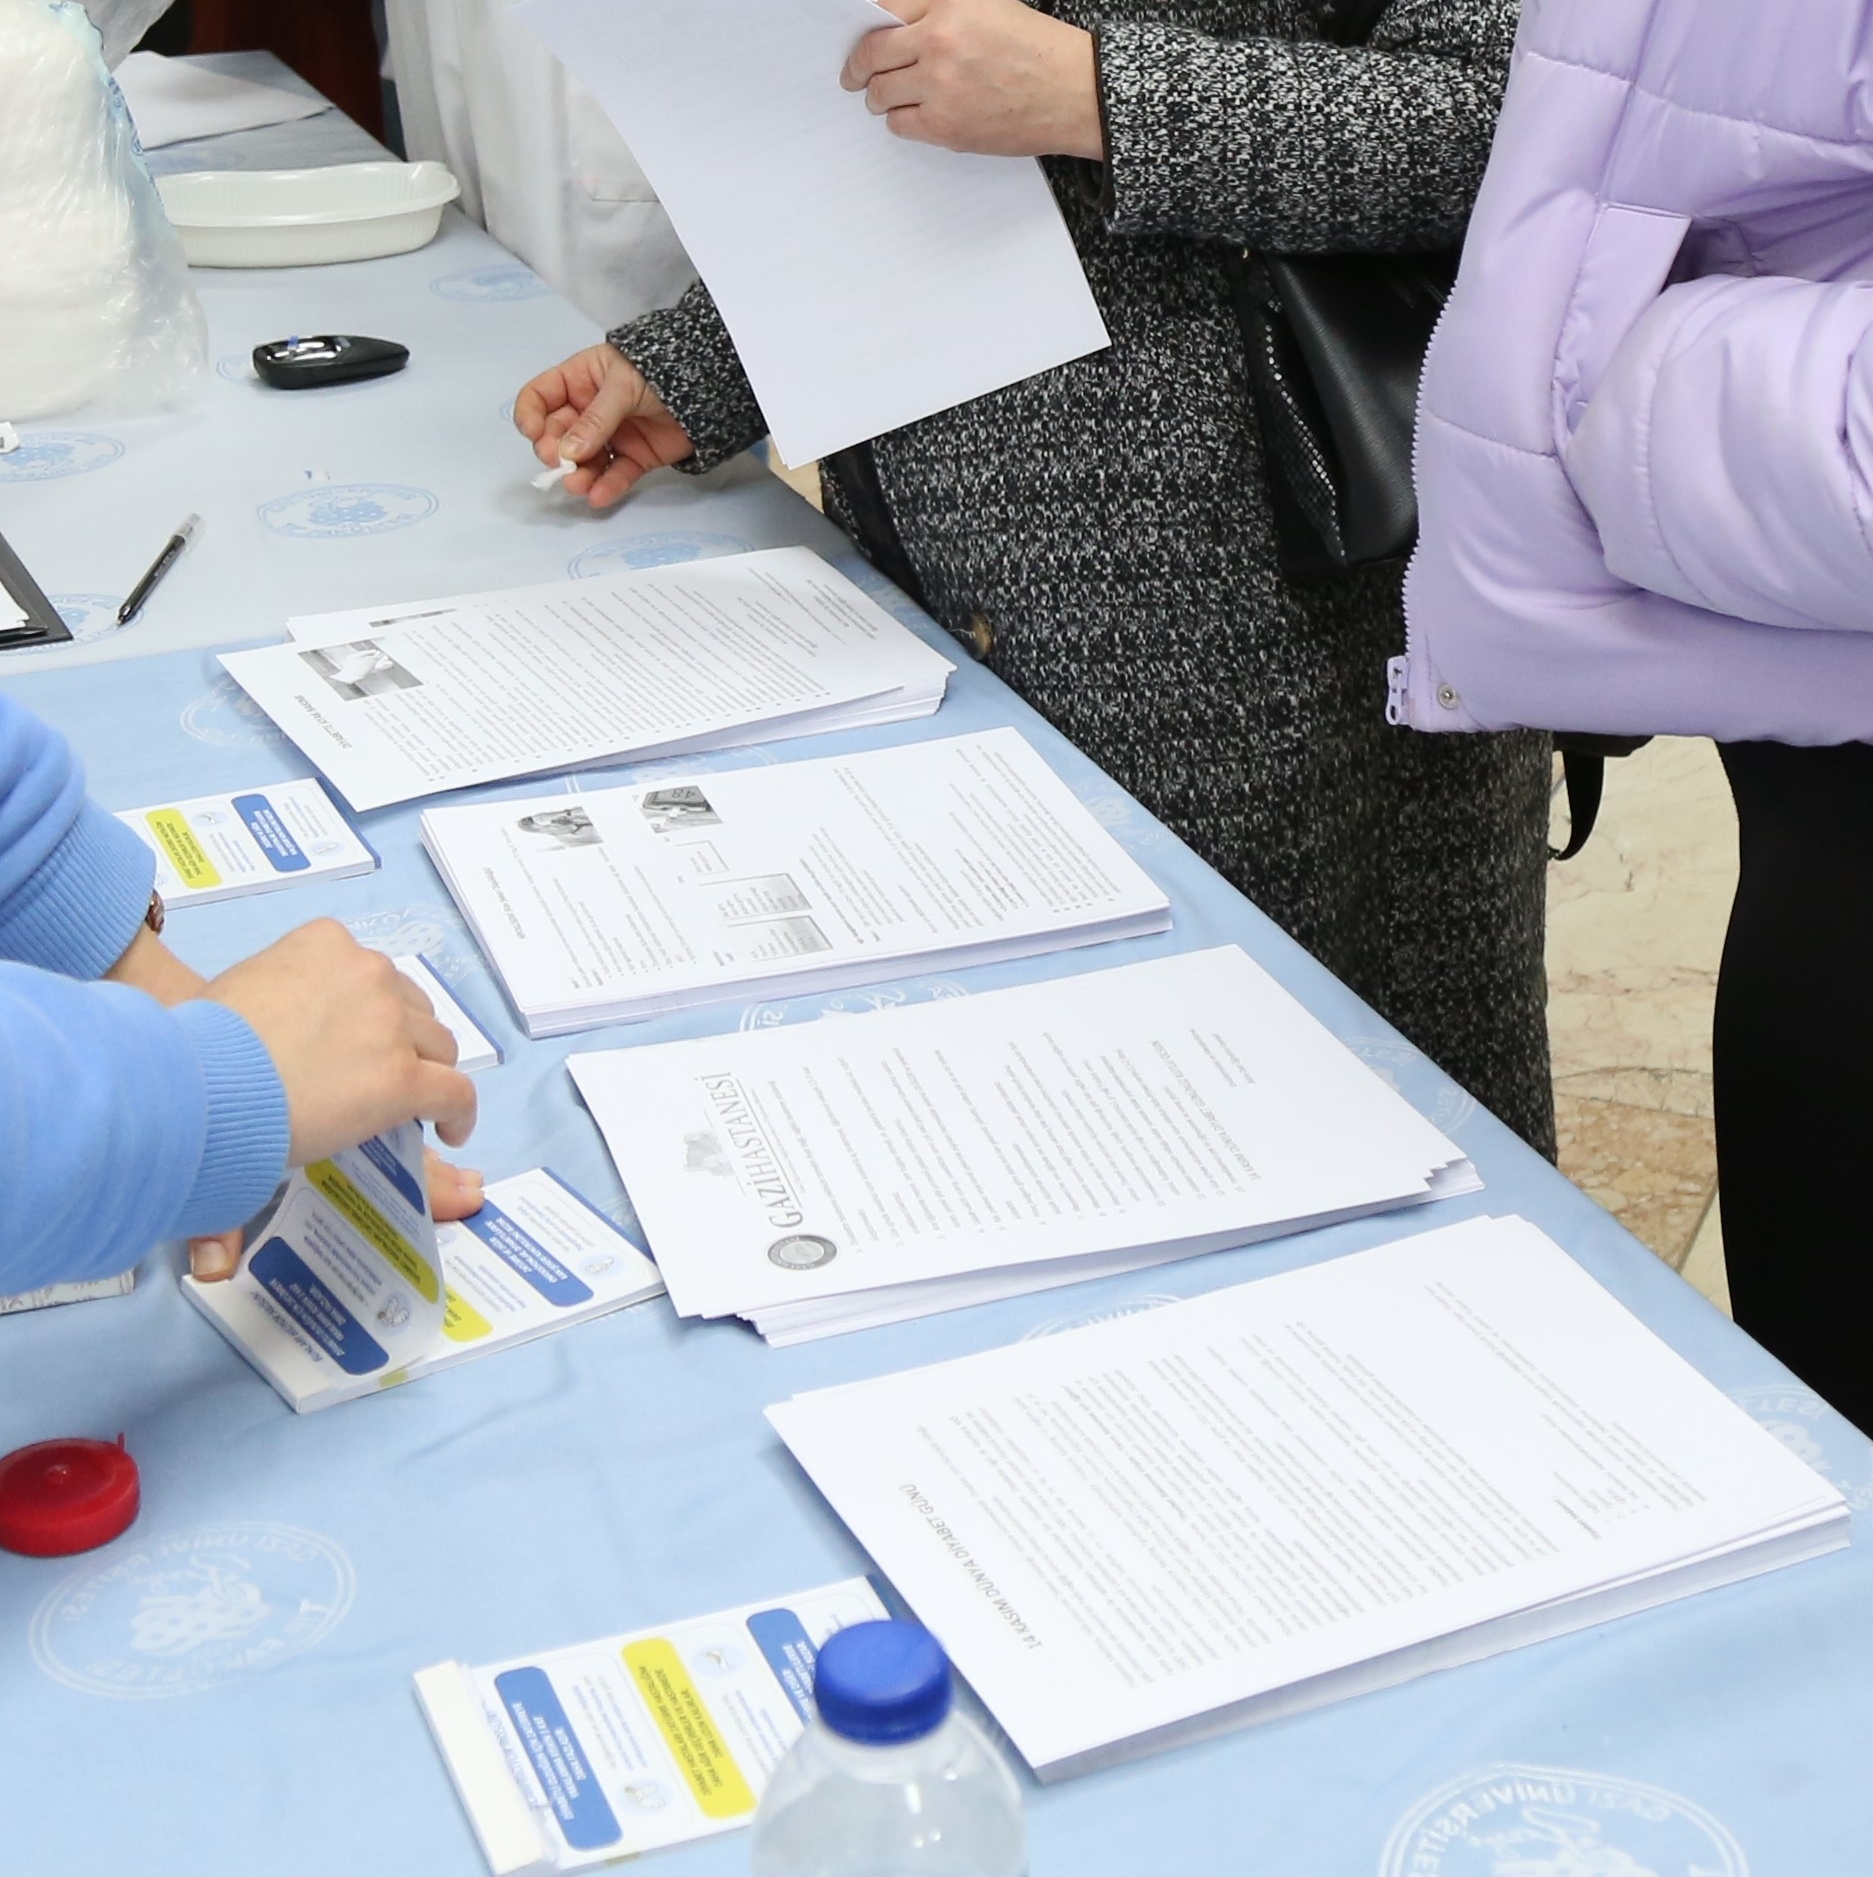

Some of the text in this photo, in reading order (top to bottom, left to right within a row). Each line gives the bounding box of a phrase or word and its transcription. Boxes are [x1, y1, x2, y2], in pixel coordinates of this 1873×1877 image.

[895, 1481, 1046, 1651] 14 KASIM DÜNYA DİYABET GÜNÜ
